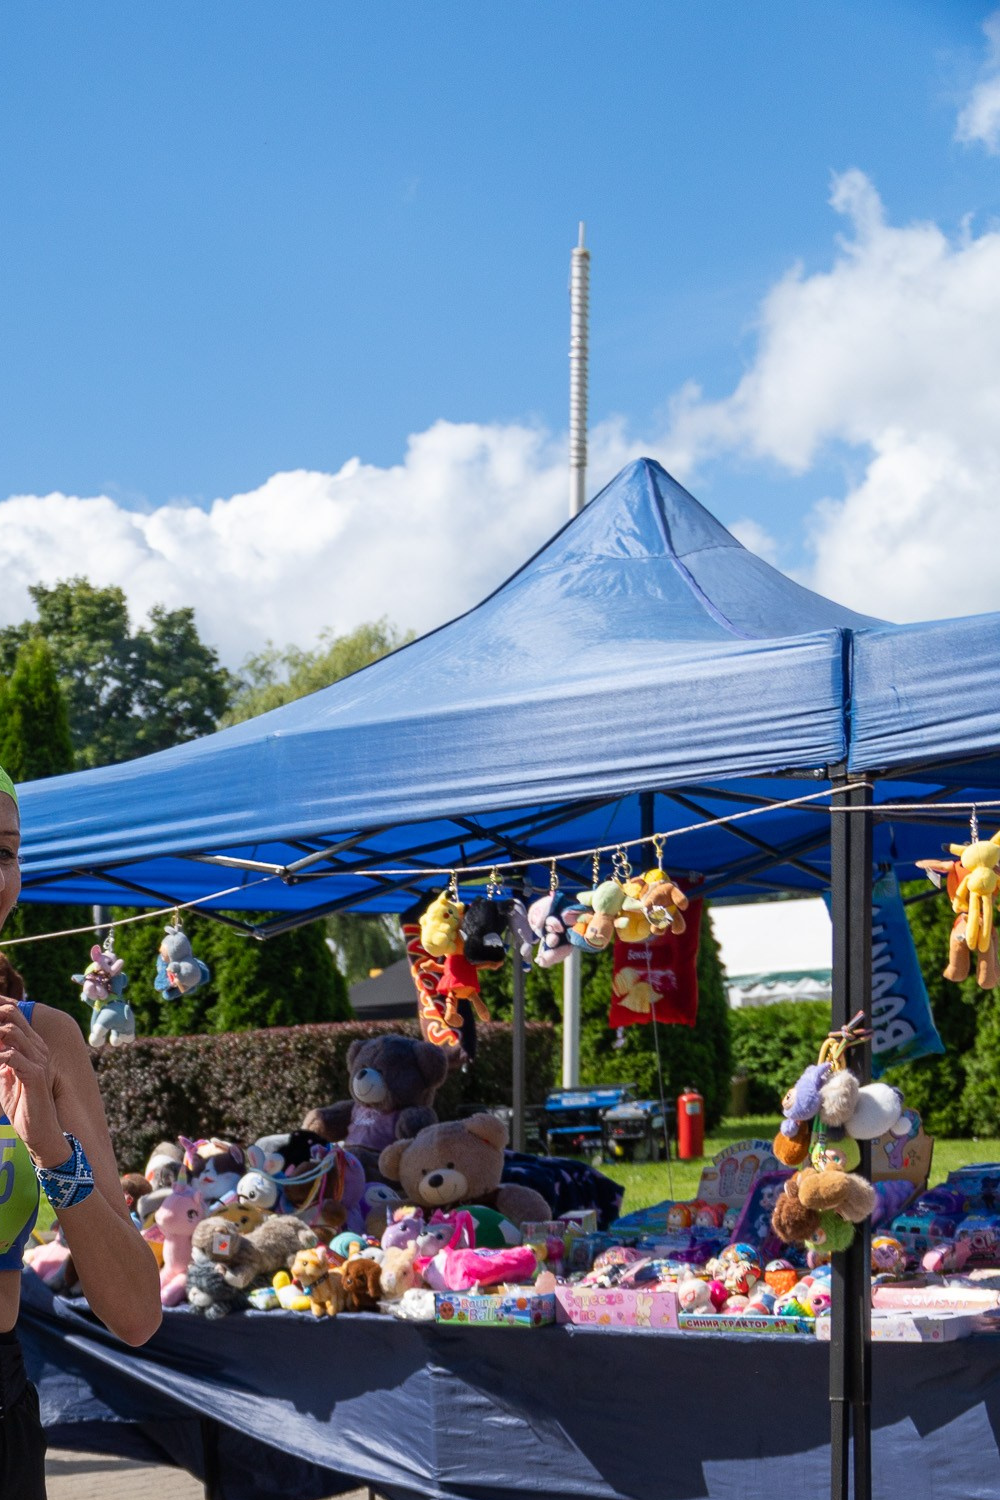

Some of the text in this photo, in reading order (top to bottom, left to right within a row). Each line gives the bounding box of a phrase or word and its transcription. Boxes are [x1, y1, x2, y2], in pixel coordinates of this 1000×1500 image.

[564, 1289, 624, 1309] Squeeze
[468, 1308, 495, 1323] Ball
[579, 1309, 596, 1321] me
[721, 1319, 768, 1329] ТРАКТОР
